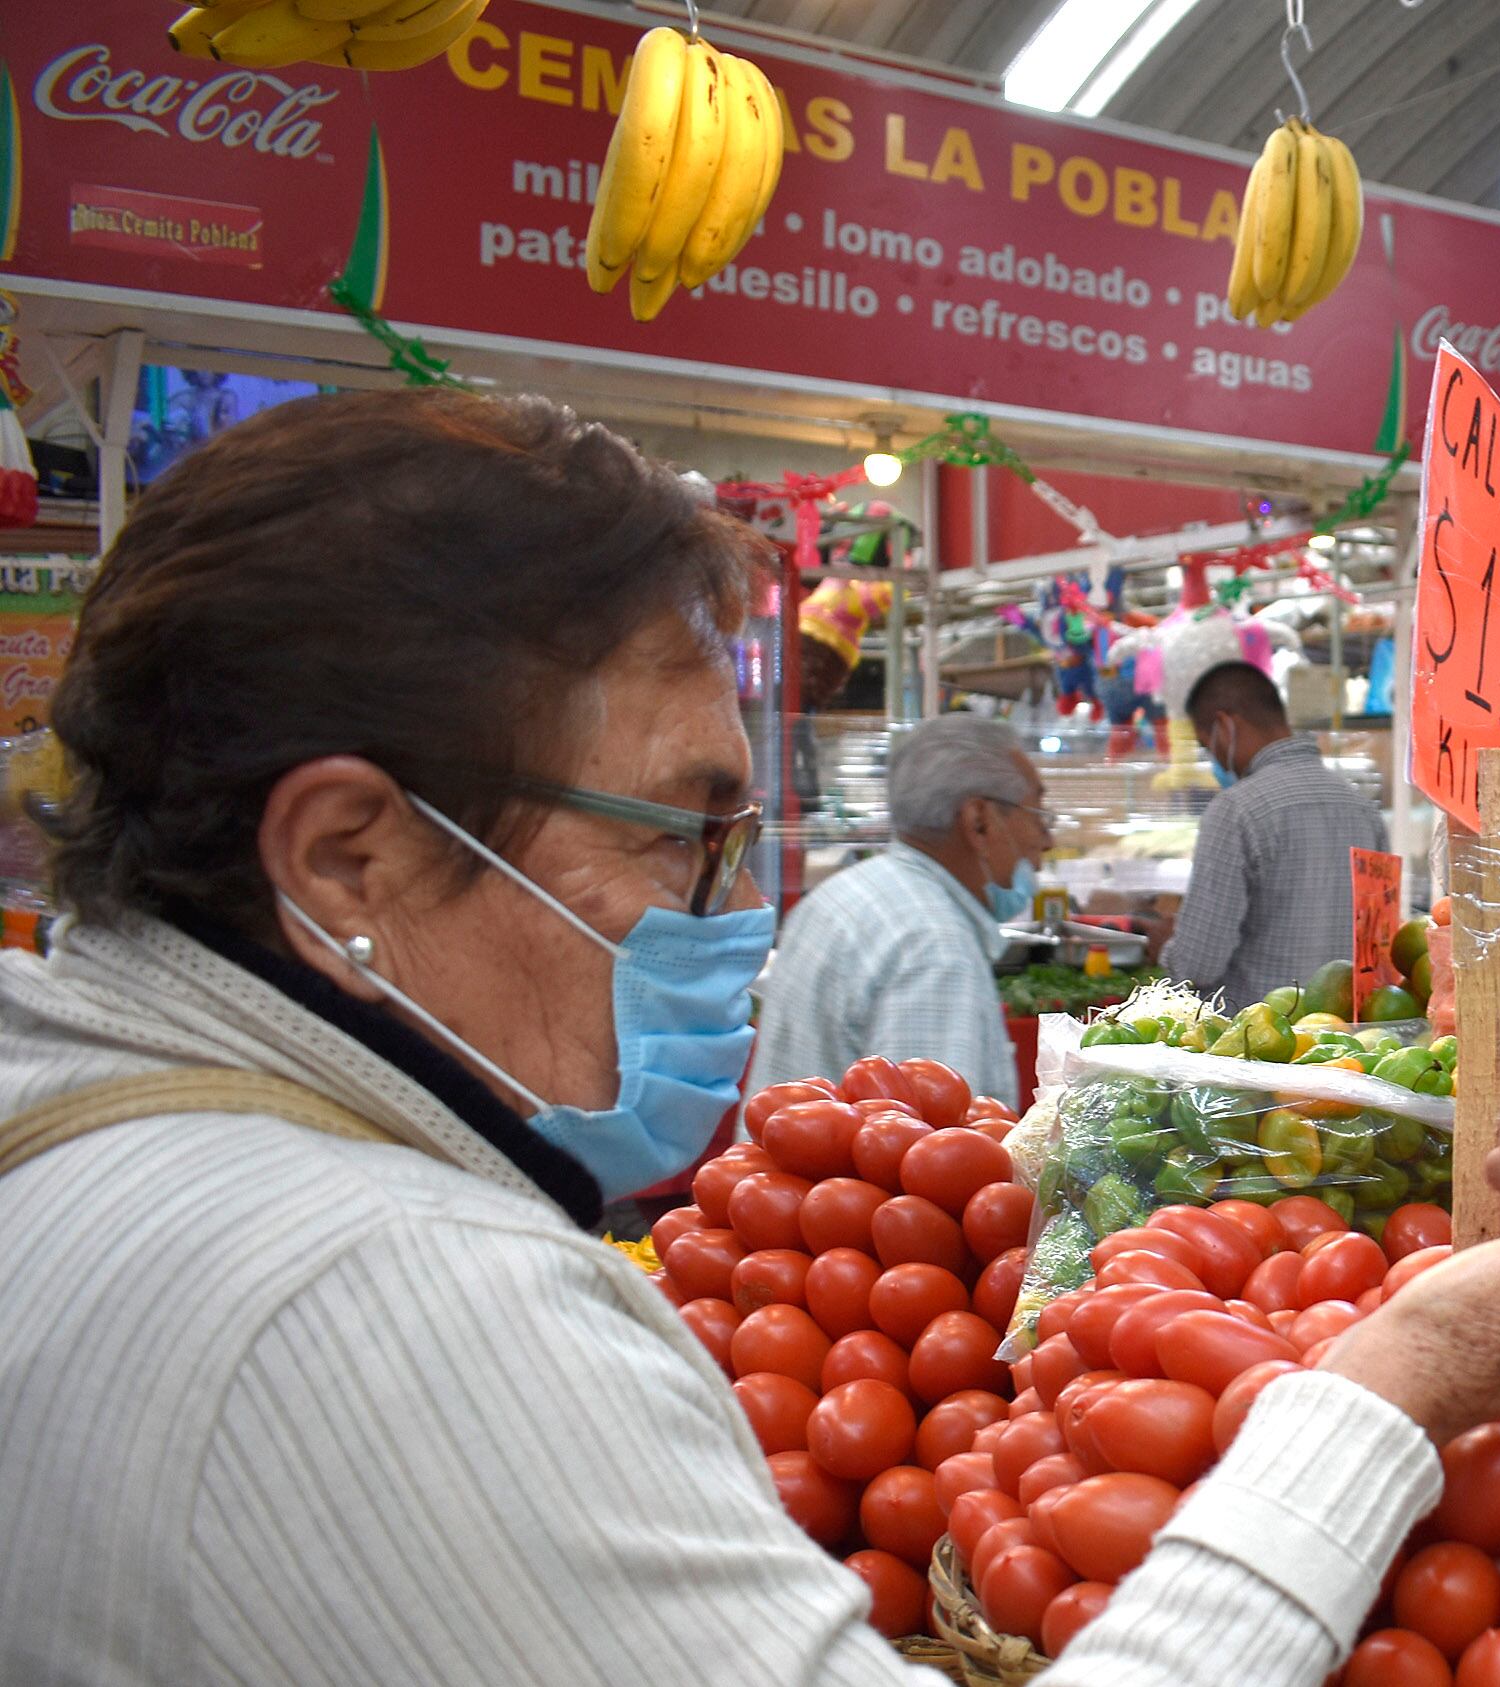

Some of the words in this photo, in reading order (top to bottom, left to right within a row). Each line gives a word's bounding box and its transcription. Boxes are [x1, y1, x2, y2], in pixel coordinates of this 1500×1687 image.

[33, 43, 340, 158] Coca-Cola
[446, 20, 855, 163] CEMS
[886, 114, 984, 191] LA
[1011, 143, 1240, 246] POBLA
[823, 209, 943, 268] lomo
[959, 245, 1150, 307] adobado
[690, 262, 878, 316] uesillo
[932, 298, 1147, 364] refrescos
[1193, 347, 1313, 391] aguas
[1437, 715, 1479, 812] KI
